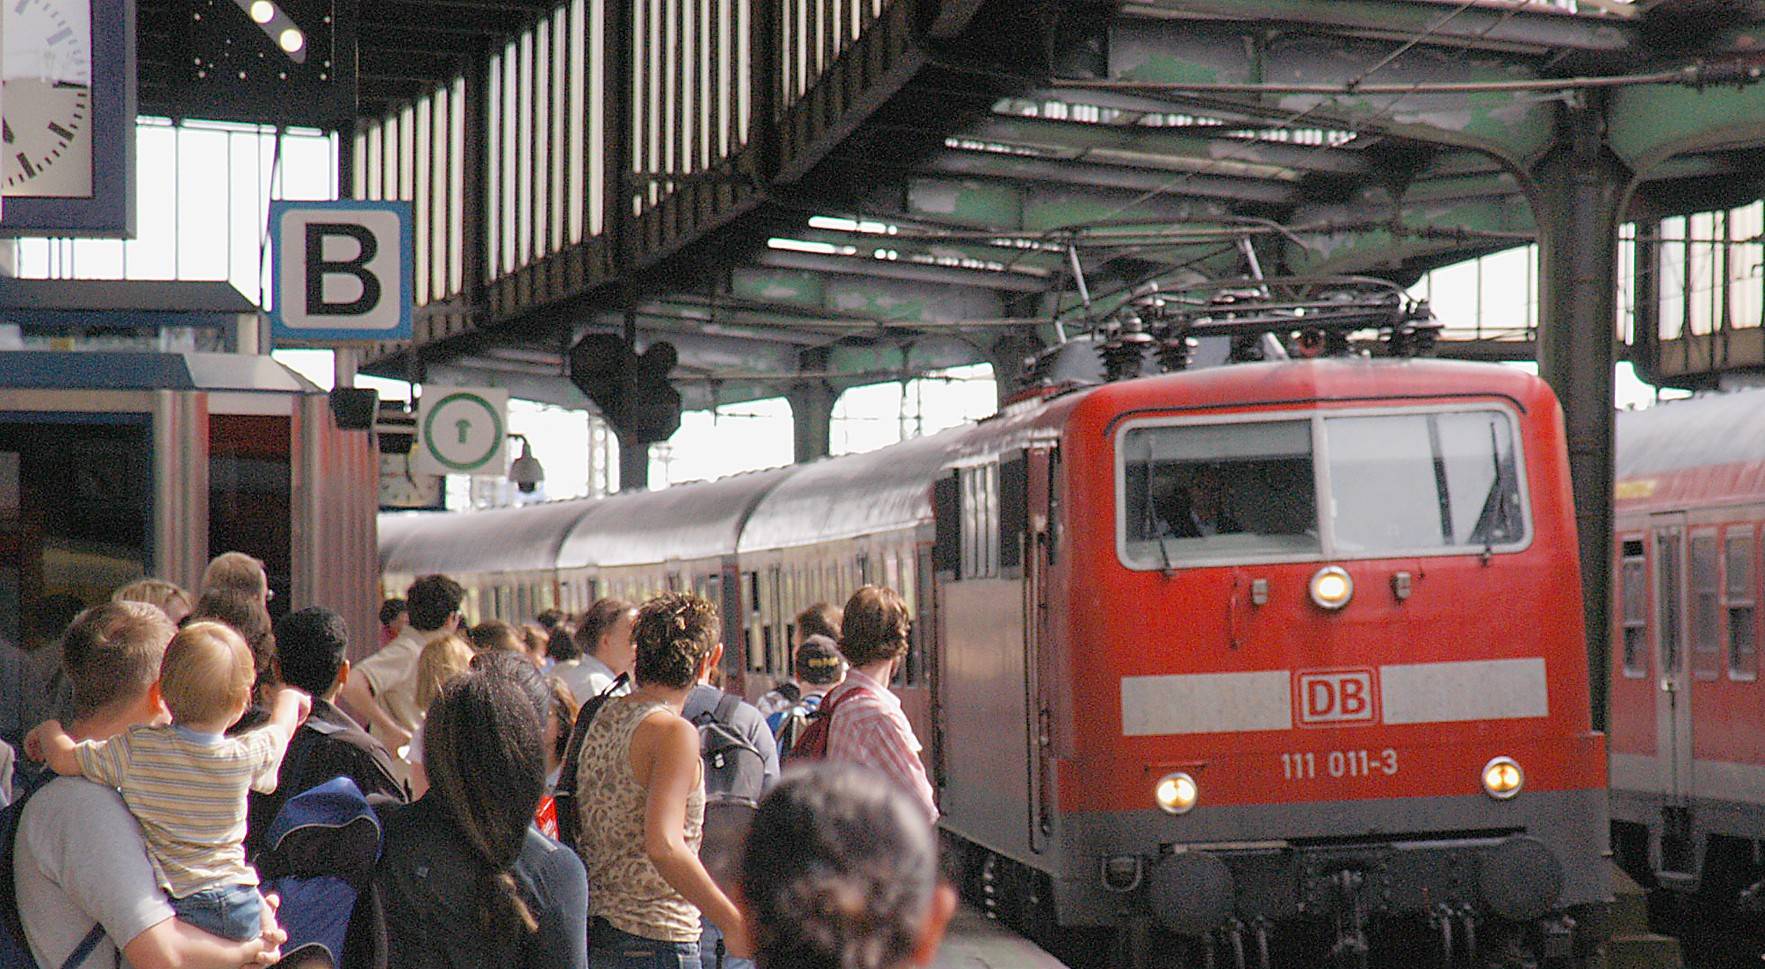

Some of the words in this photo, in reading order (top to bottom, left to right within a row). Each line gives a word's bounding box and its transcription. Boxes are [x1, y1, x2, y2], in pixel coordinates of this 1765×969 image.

[305, 222, 381, 316] B
[1307, 678, 1366, 716] DB
[1282, 752, 1315, 780] 111
[1328, 748, 1398, 777] 011-3
